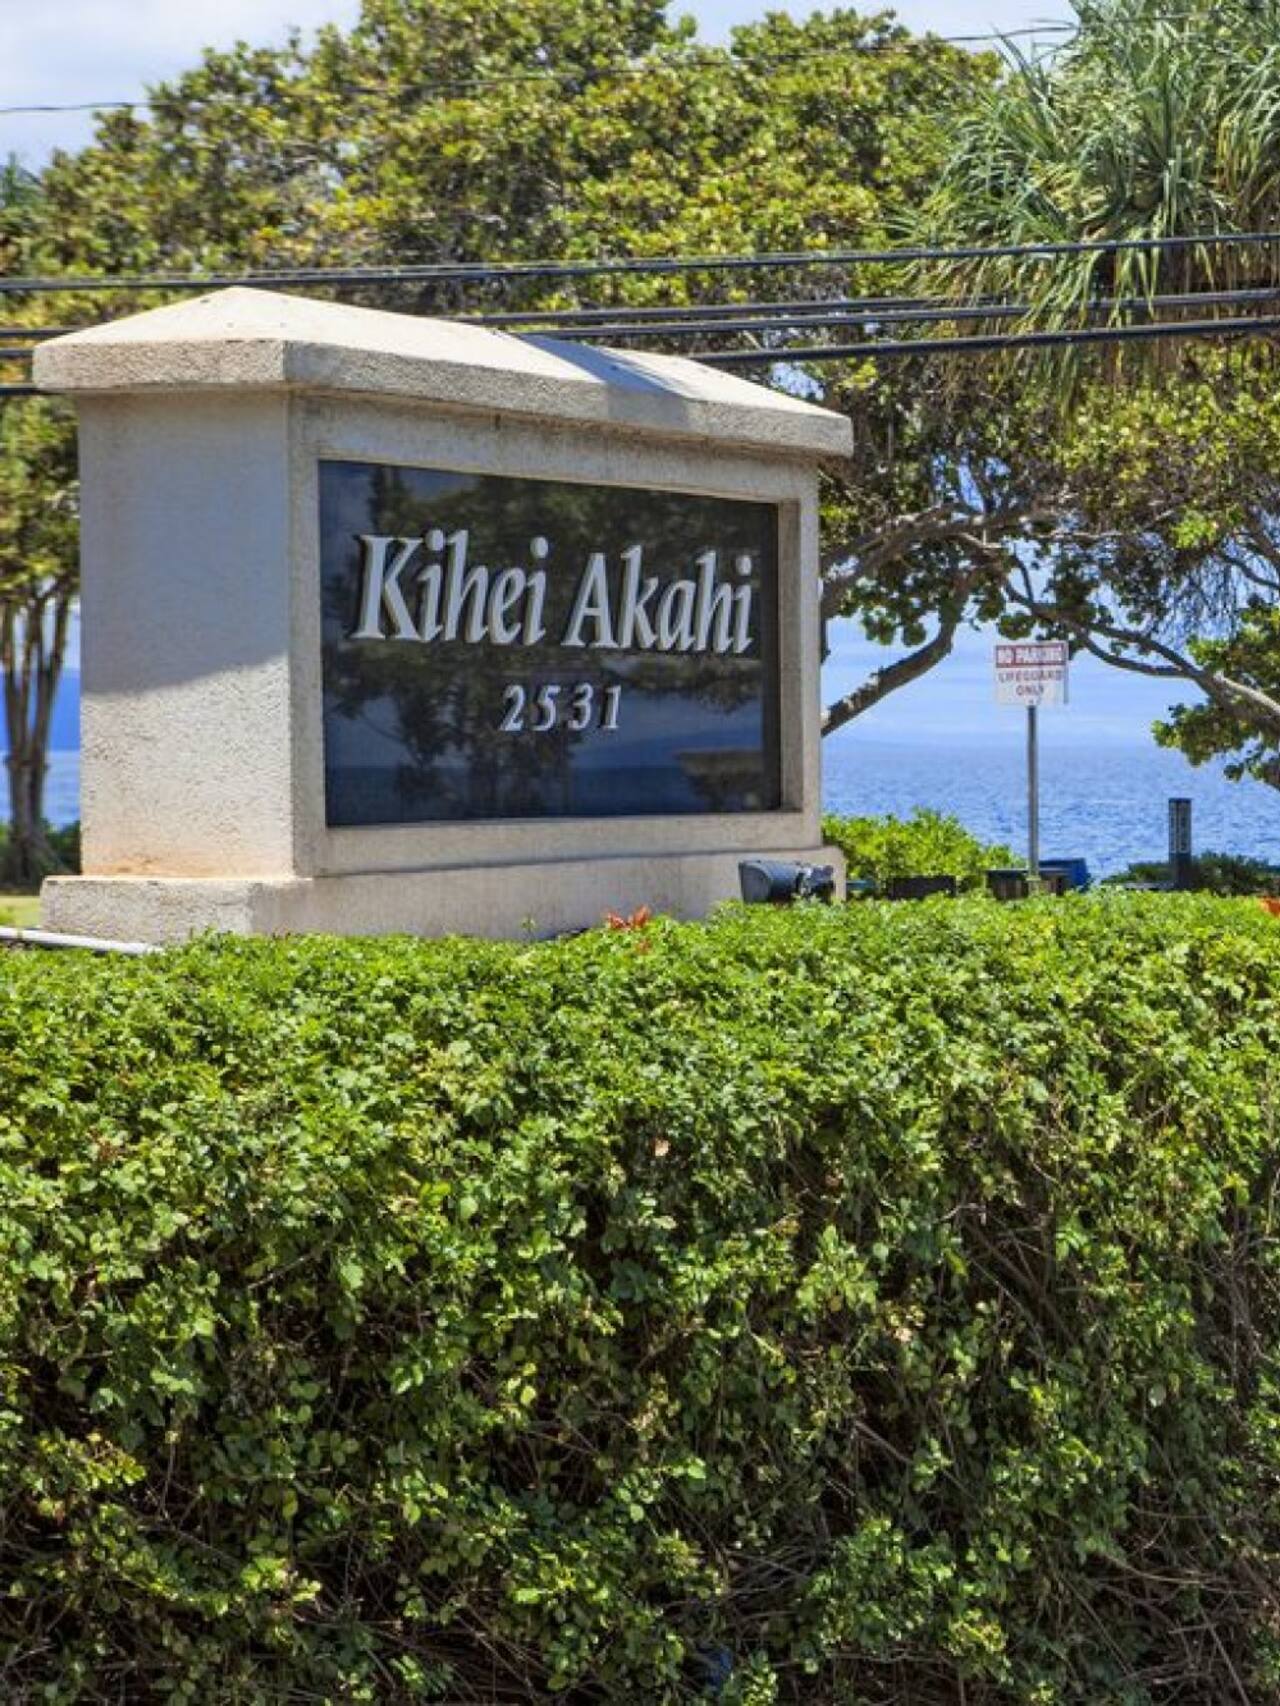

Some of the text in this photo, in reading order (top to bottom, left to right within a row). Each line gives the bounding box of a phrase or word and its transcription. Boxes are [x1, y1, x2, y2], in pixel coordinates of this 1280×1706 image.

[350, 529, 754, 654] Kihei Akahi
[501, 683, 622, 732] 2531
[1016, 685, 1044, 696] ONLY
